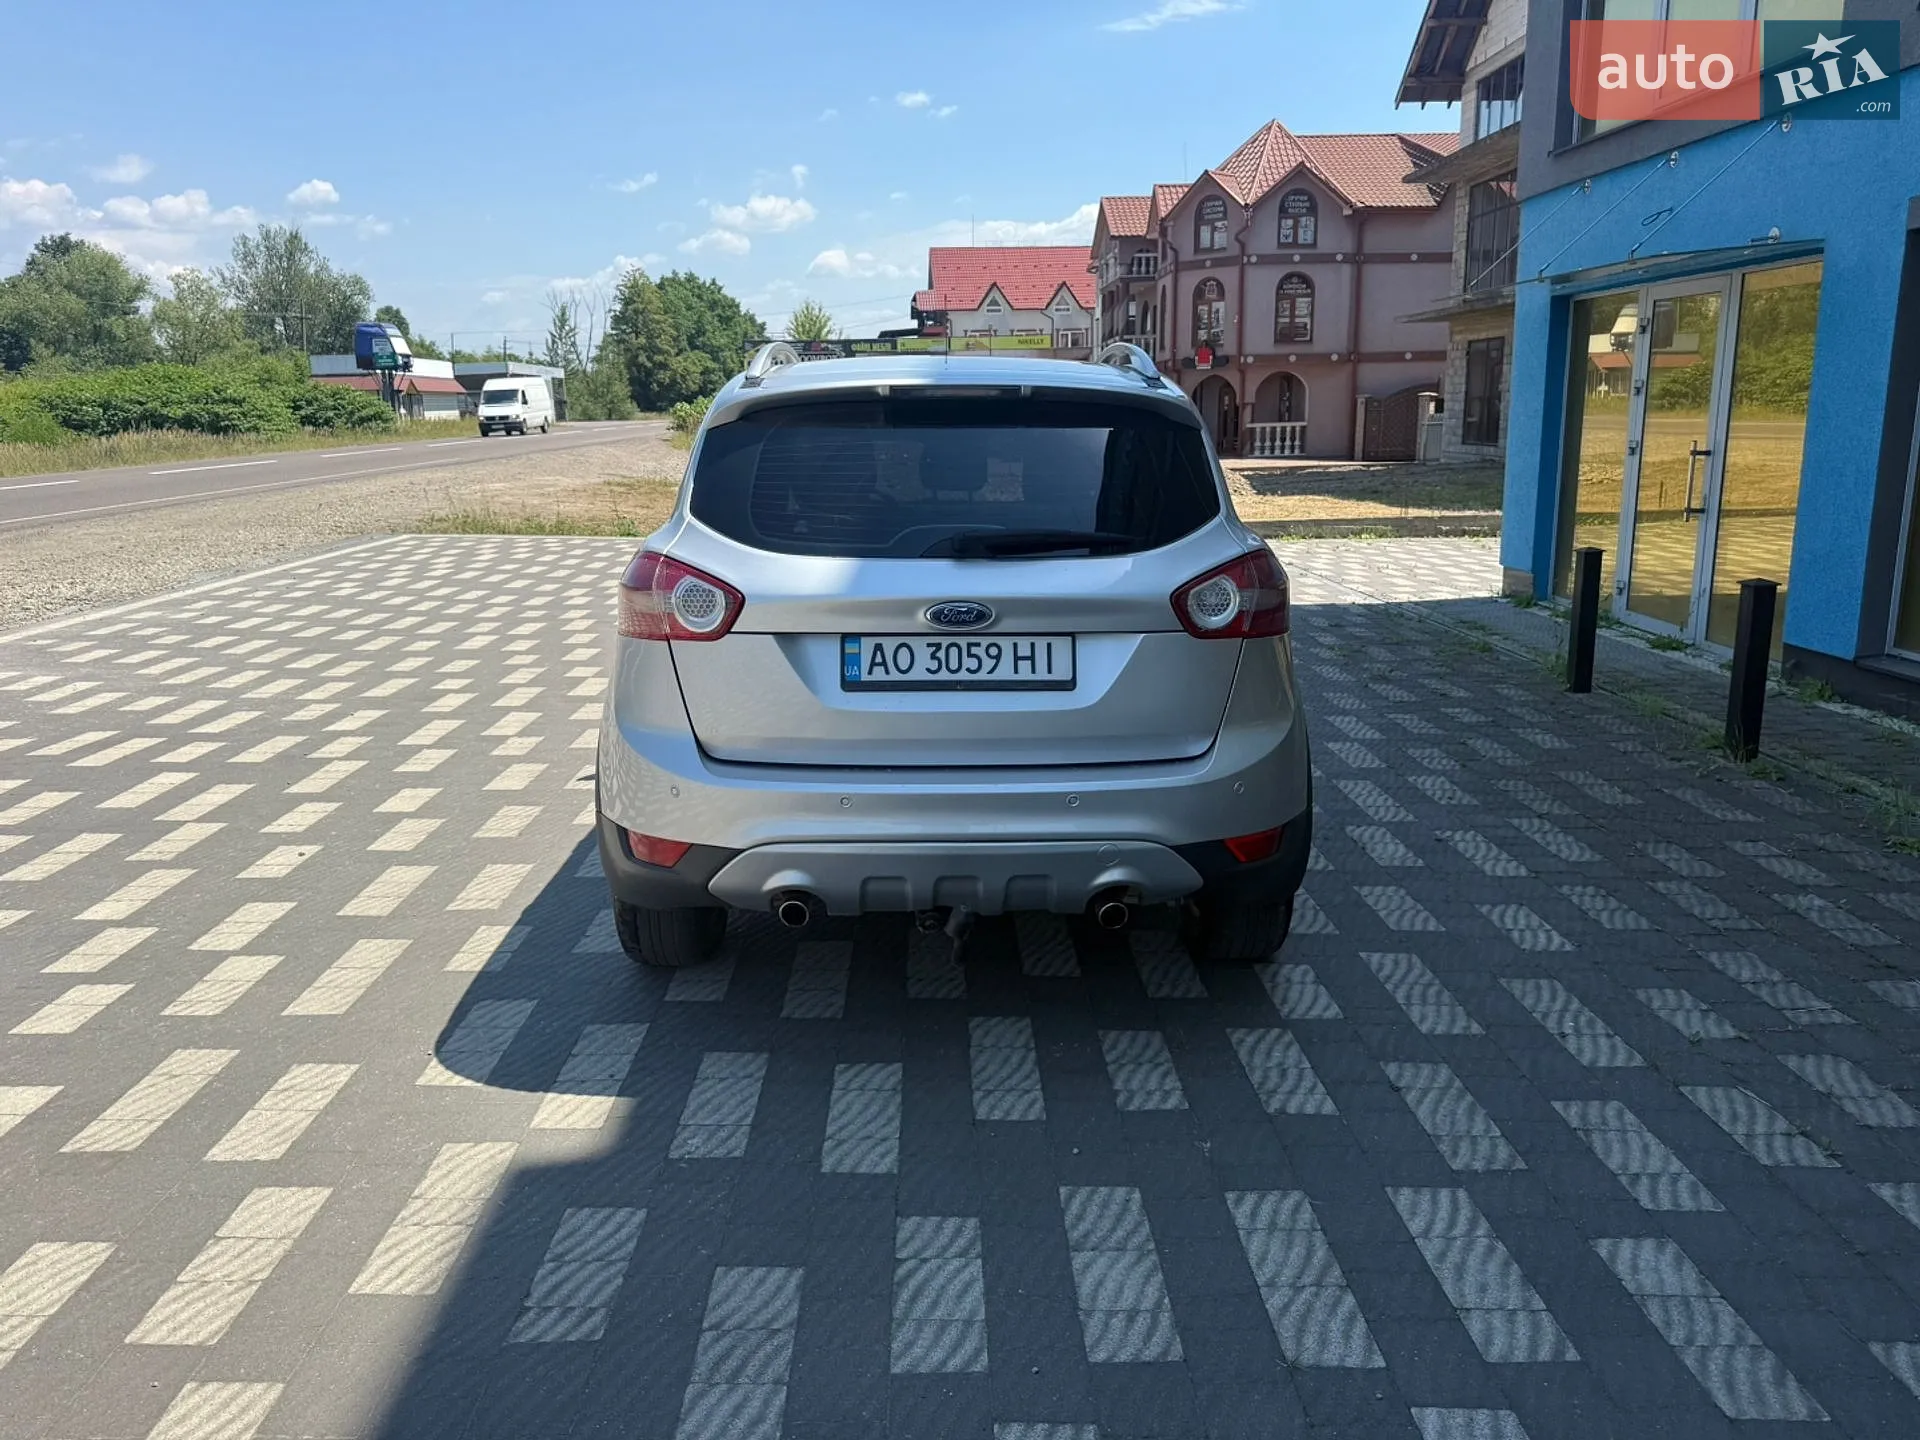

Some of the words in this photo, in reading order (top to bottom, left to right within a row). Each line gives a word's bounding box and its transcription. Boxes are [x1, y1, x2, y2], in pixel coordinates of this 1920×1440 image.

[940, 607, 978, 622] Ford
[867, 642, 915, 675] AO
[925, 642, 1002, 675] 3059
[1012, 641, 1053, 675] HI
[844, 665, 860, 676] UA
